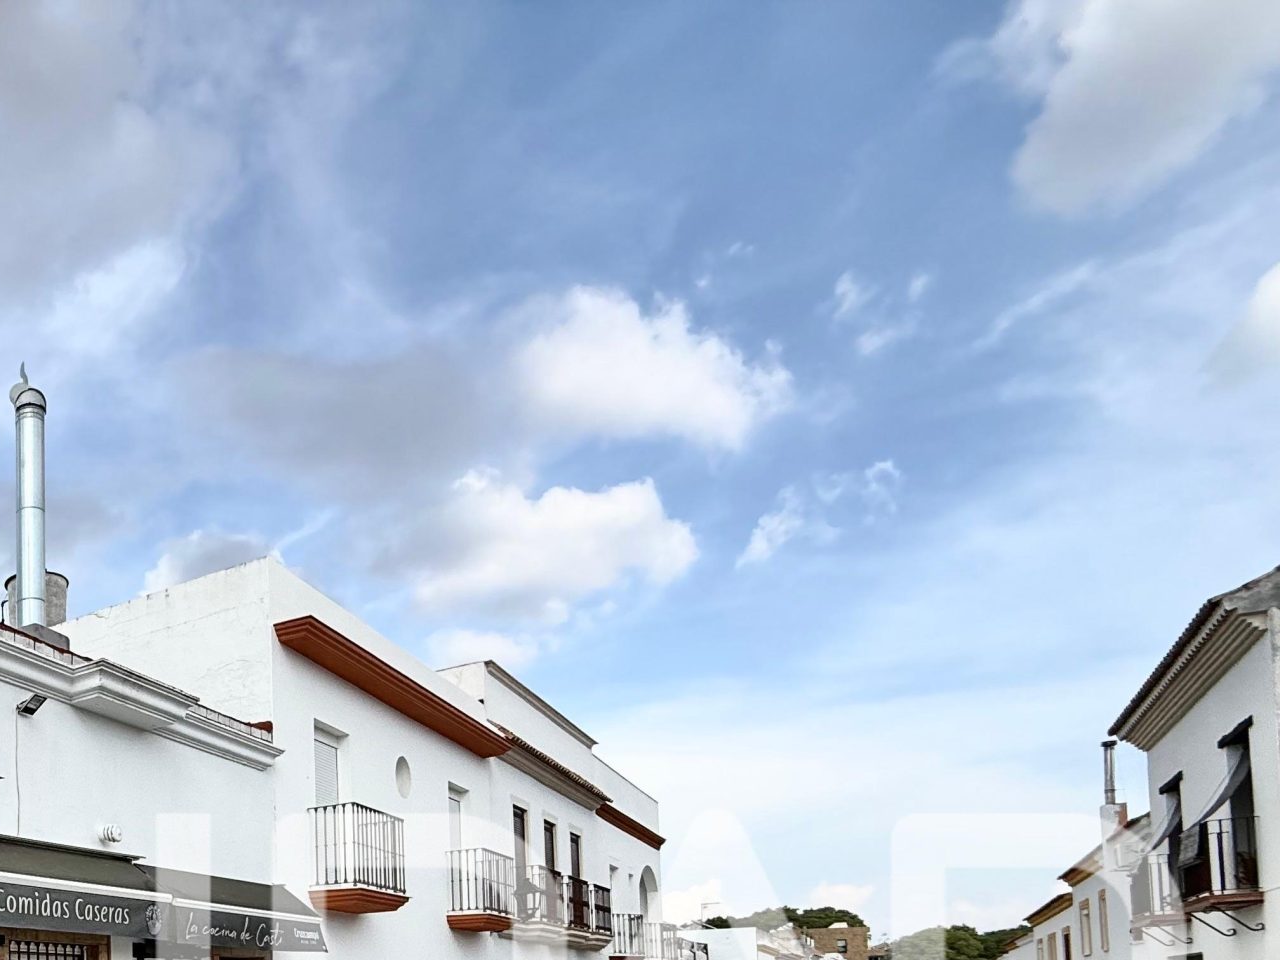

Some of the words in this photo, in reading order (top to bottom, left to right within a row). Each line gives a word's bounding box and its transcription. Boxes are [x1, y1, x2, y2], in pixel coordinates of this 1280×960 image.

[75, 898, 130, 925] Caseras
[185, 911, 199, 940] La
[202, 923, 238, 940] cocina
[240, 916, 254, 945] de
